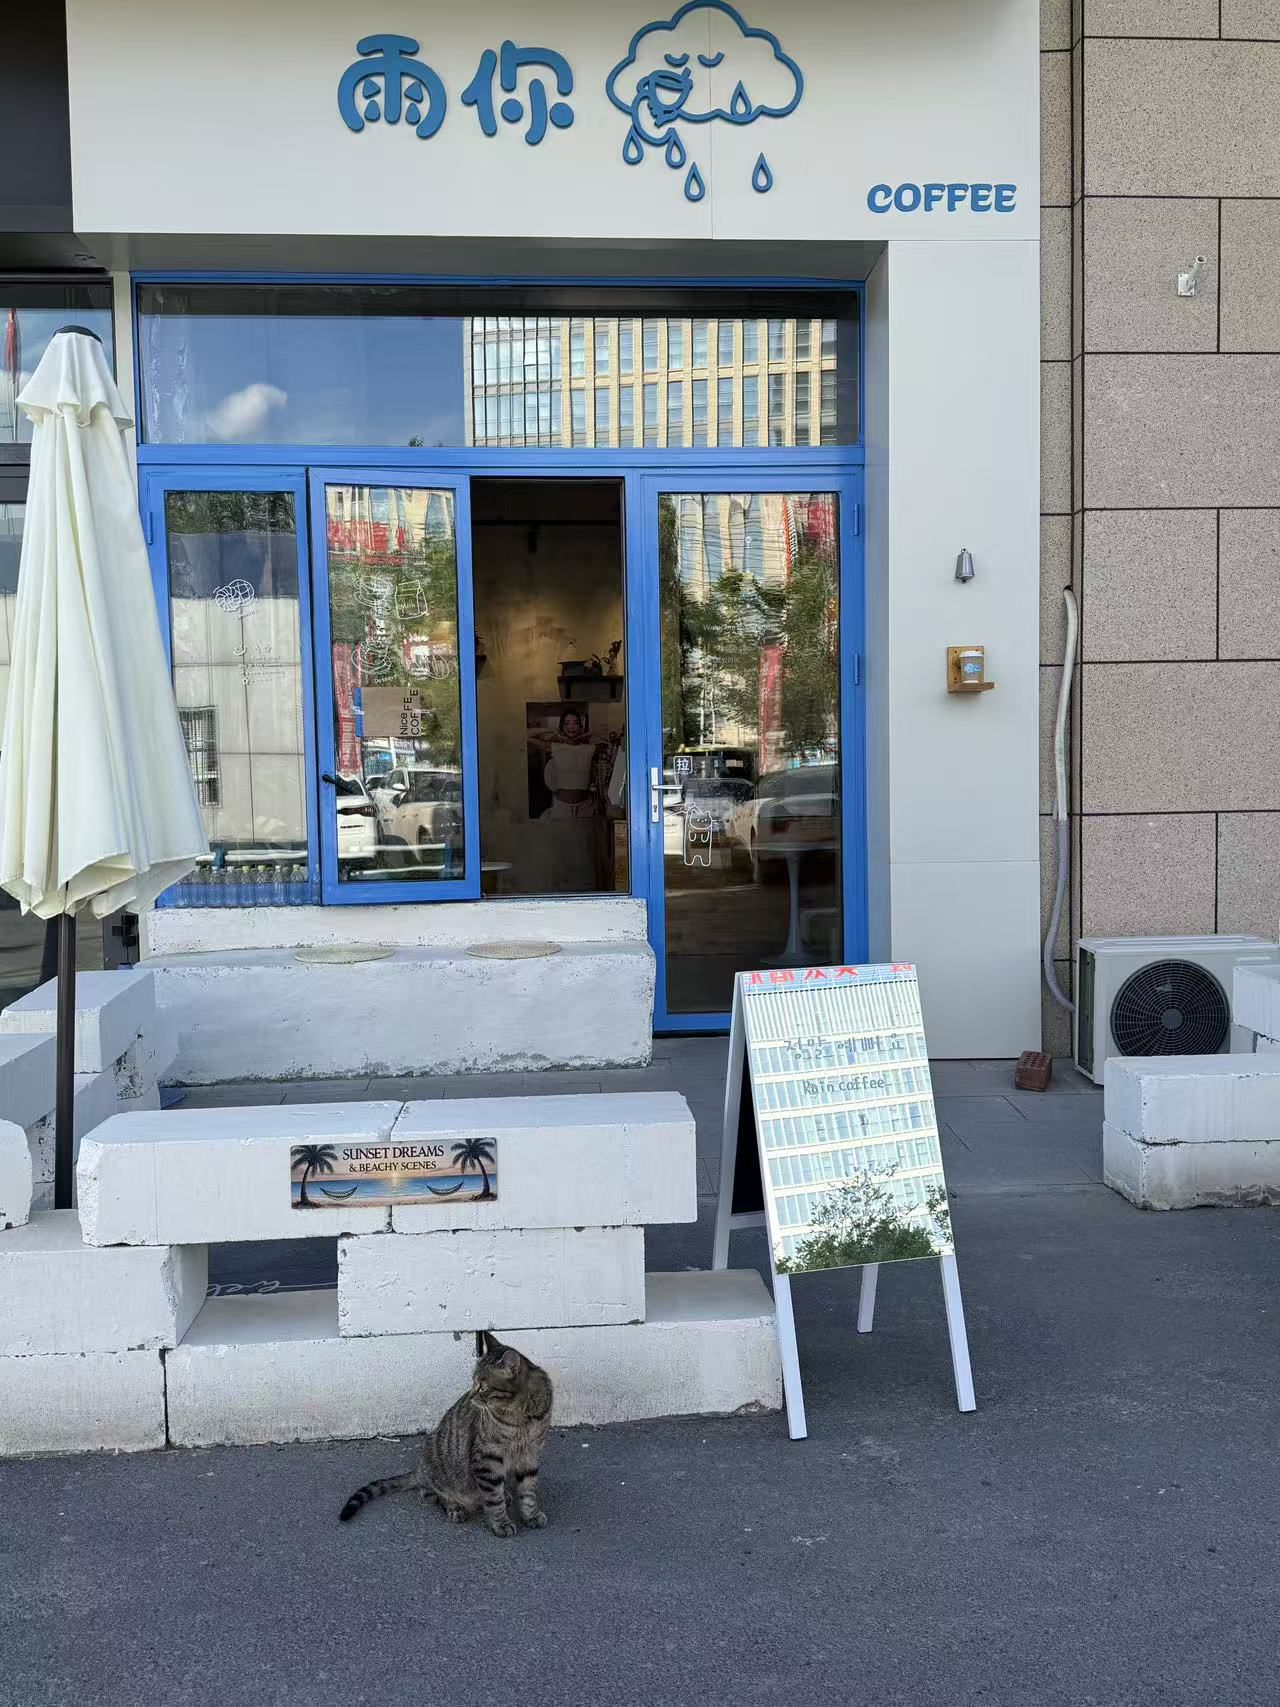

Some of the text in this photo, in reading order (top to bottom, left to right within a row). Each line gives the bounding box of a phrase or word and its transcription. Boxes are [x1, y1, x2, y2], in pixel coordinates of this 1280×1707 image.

[867, 183, 1017, 213] COFFEE
[400, 712, 408, 736] Nice
[677, 758, 690, 771] 拉
[803, 1076, 886, 1096] Rain coffee
[342, 1145, 445, 1160] SUNSET DREAMS
[349, 1161, 437, 1173] & BEACHY SCENES
